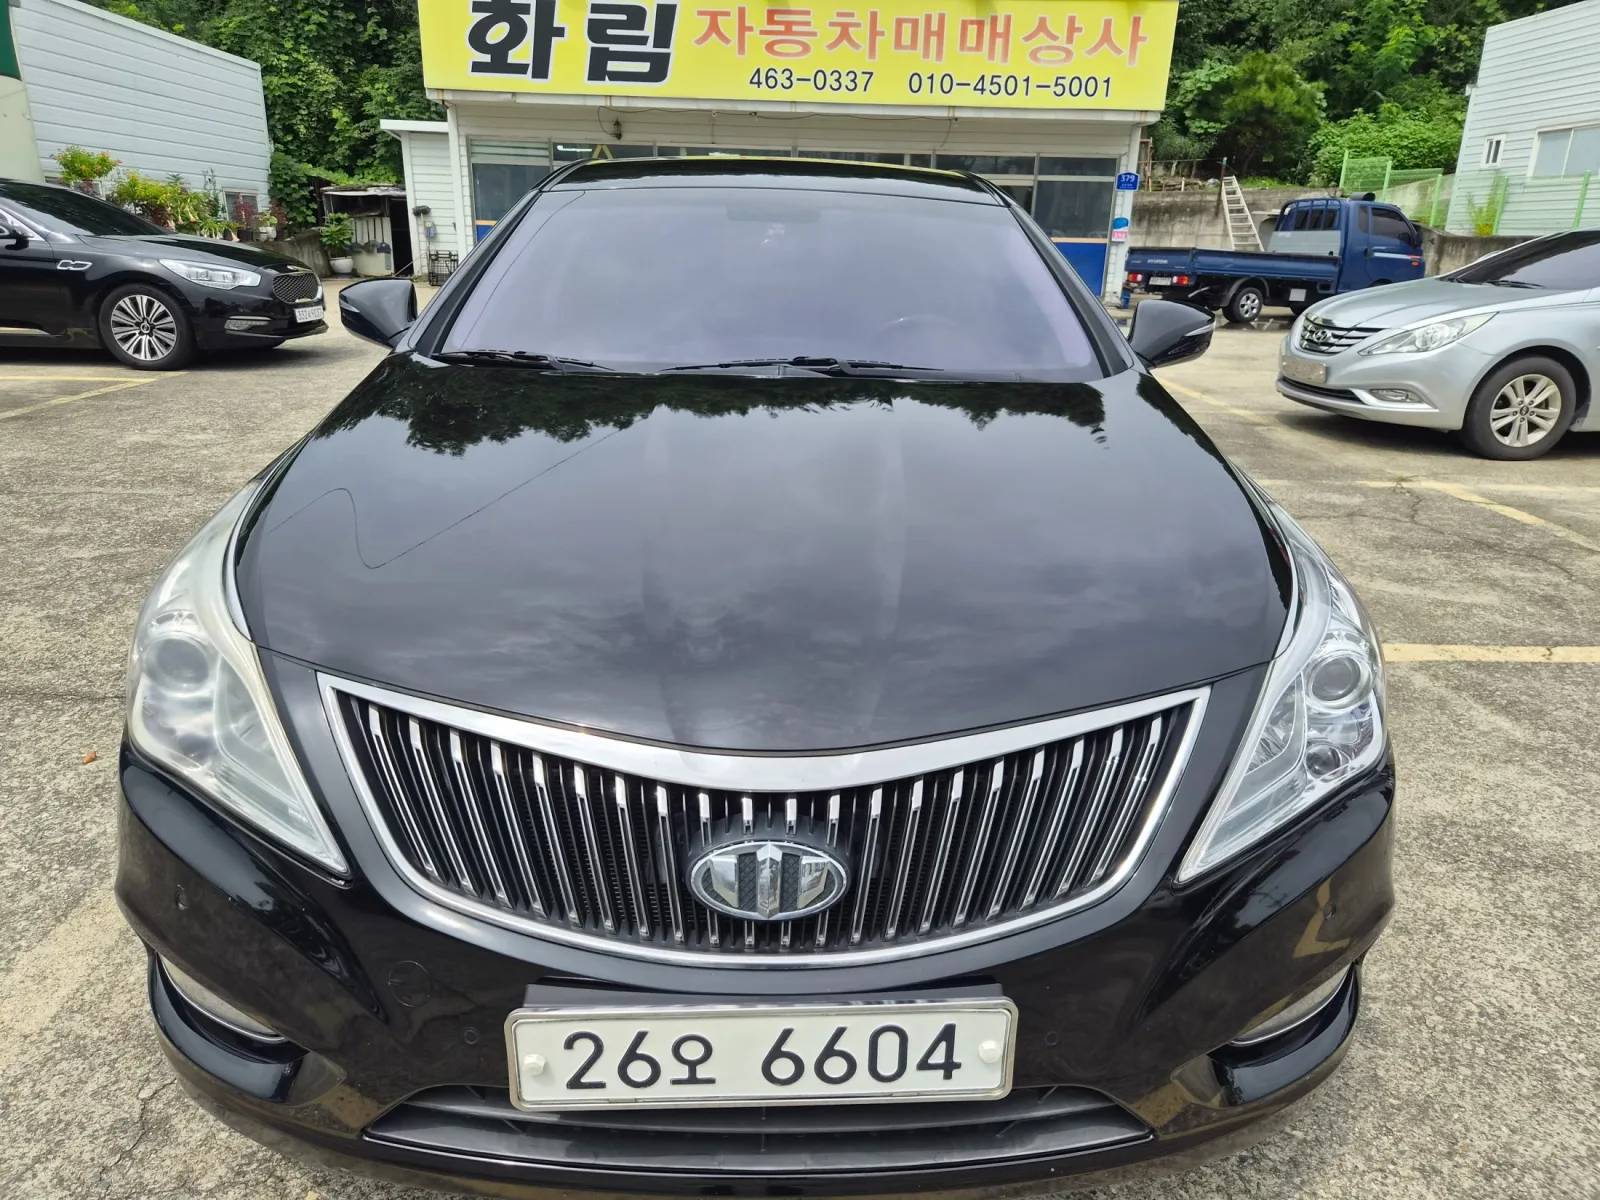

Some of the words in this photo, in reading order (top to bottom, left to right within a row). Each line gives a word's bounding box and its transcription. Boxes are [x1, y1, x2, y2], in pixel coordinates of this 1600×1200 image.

[468, 0, 677, 83] 화림
[694, 7, 1146, 66] 자동차매매상사
[749, 67, 874, 93] 463-0337
[908, 72, 1112, 98] 010-4501-5001
[1120, 174, 1136, 183] 379
[563, 1030, 716, 1090] 26오
[761, 1022, 962, 1086] 6604
